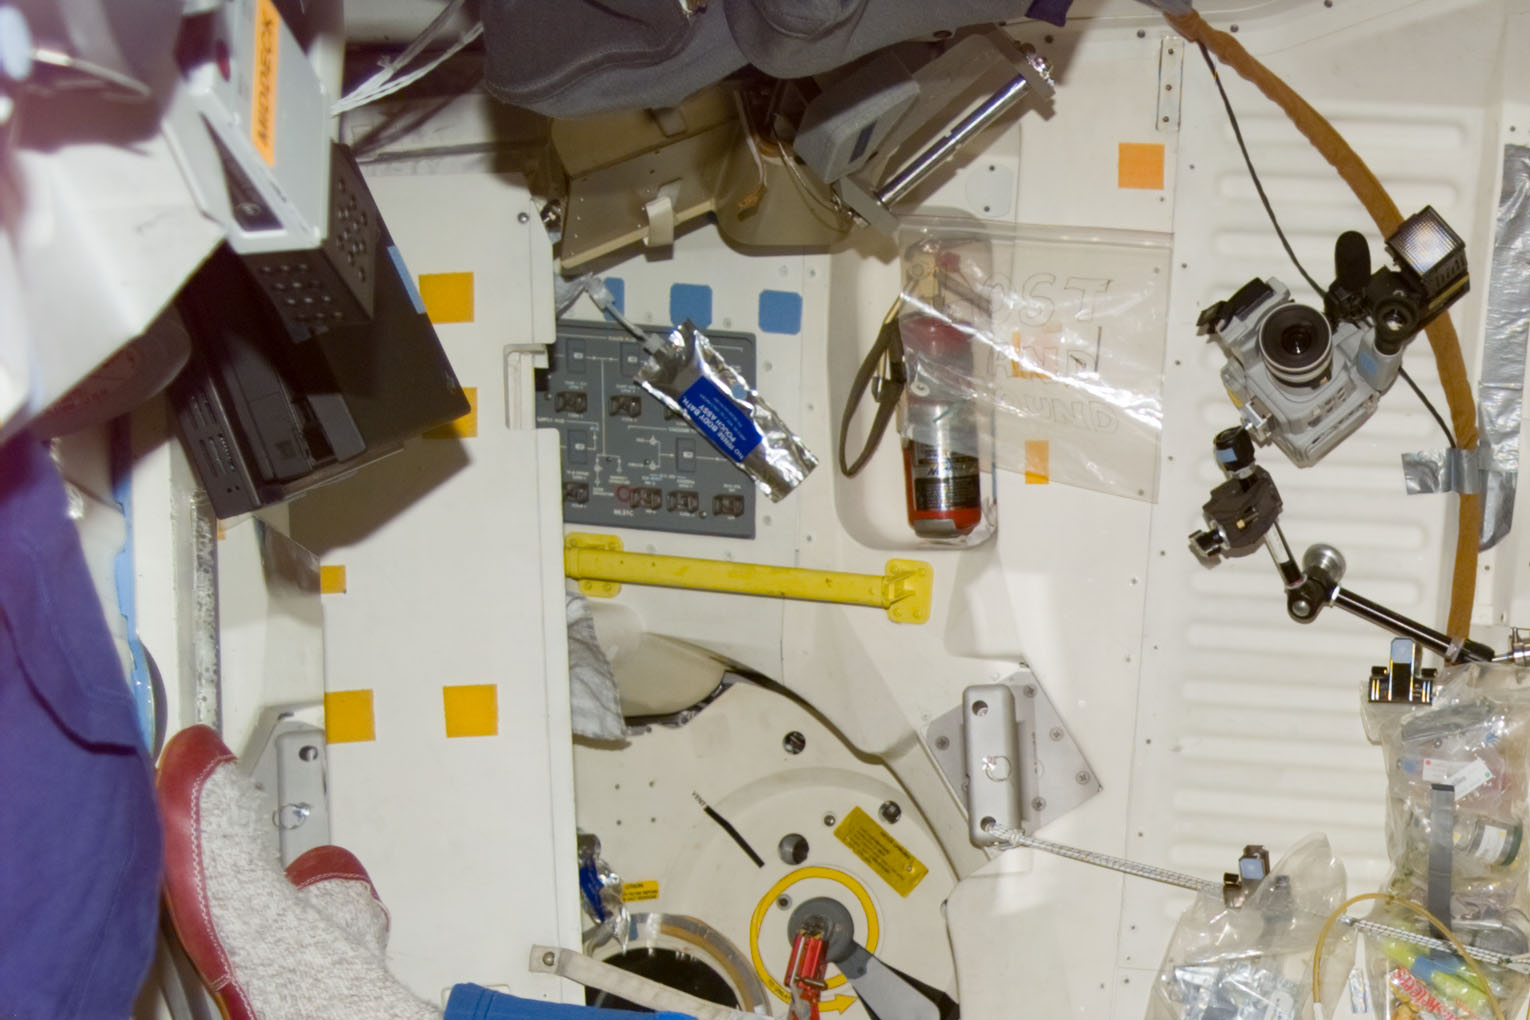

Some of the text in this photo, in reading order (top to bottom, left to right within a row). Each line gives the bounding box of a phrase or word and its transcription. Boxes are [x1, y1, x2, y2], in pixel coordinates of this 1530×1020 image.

[697, 402, 718, 422] ASSY
[697, 412, 719, 434] BODY
[713, 419, 738, 443] POUCH
